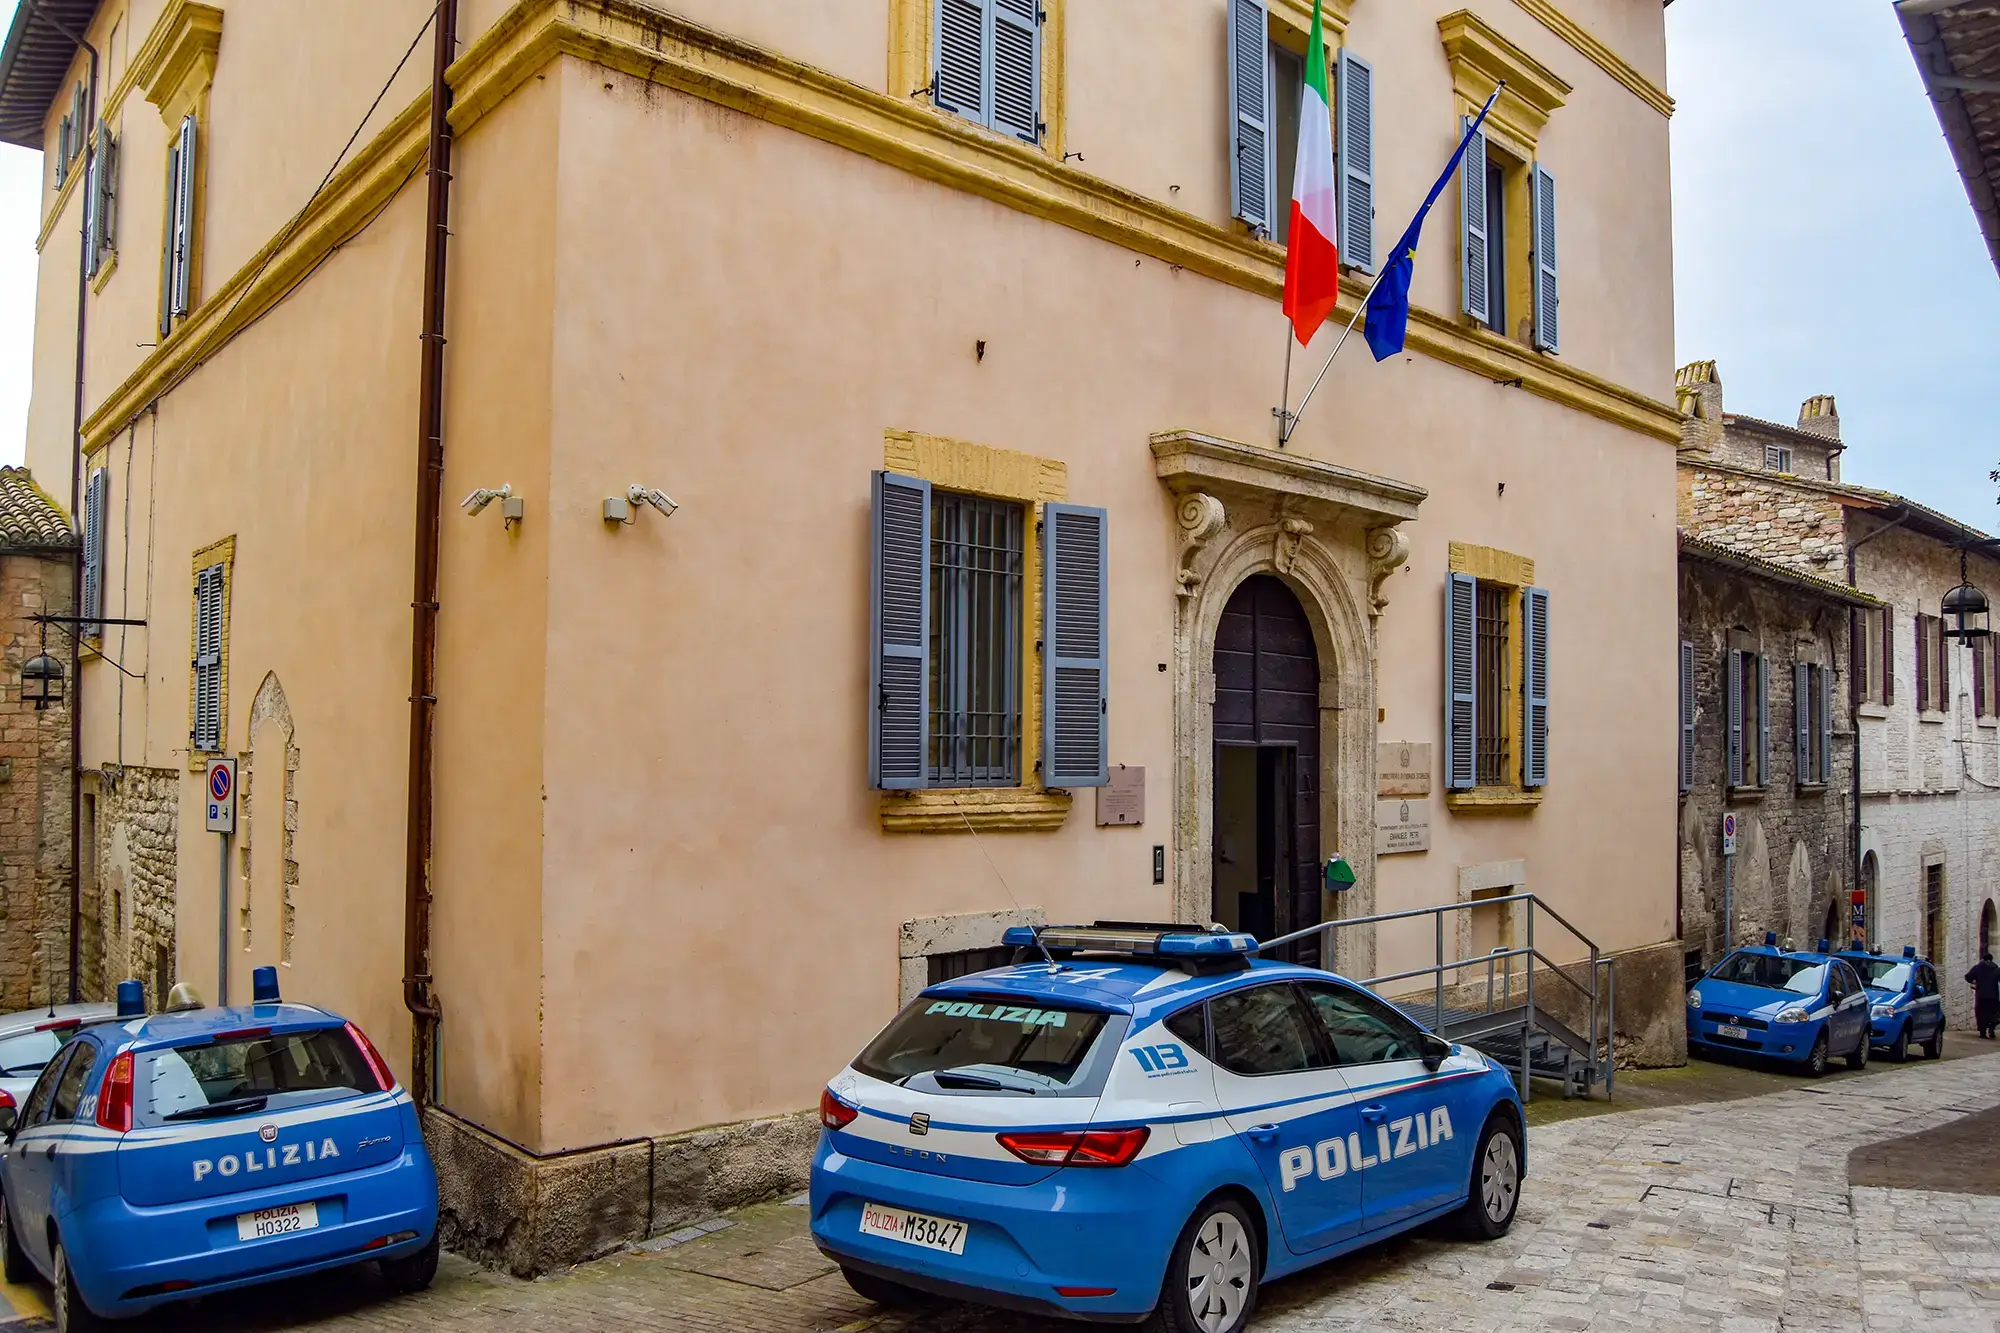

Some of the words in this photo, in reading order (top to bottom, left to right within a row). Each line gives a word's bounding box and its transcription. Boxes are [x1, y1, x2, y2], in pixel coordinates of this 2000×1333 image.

[1852, 904, 1864, 916] M
[925, 1001, 1068, 1028] POLIZIA
[1128, 1043, 1189, 1073] 113
[78, 1094, 98, 1118] 113
[192, 1137, 340, 1182] POLIZIA
[889, 1145, 947, 1163] LEON
[1279, 1104, 1453, 1193] POLIZIA
[254, 1206, 299, 1221] POLIZIA
[256, 1217, 301, 1236] H0322
[864, 1211, 899, 1232] POLIZIA
[903, 1215, 963, 1249] M3847
